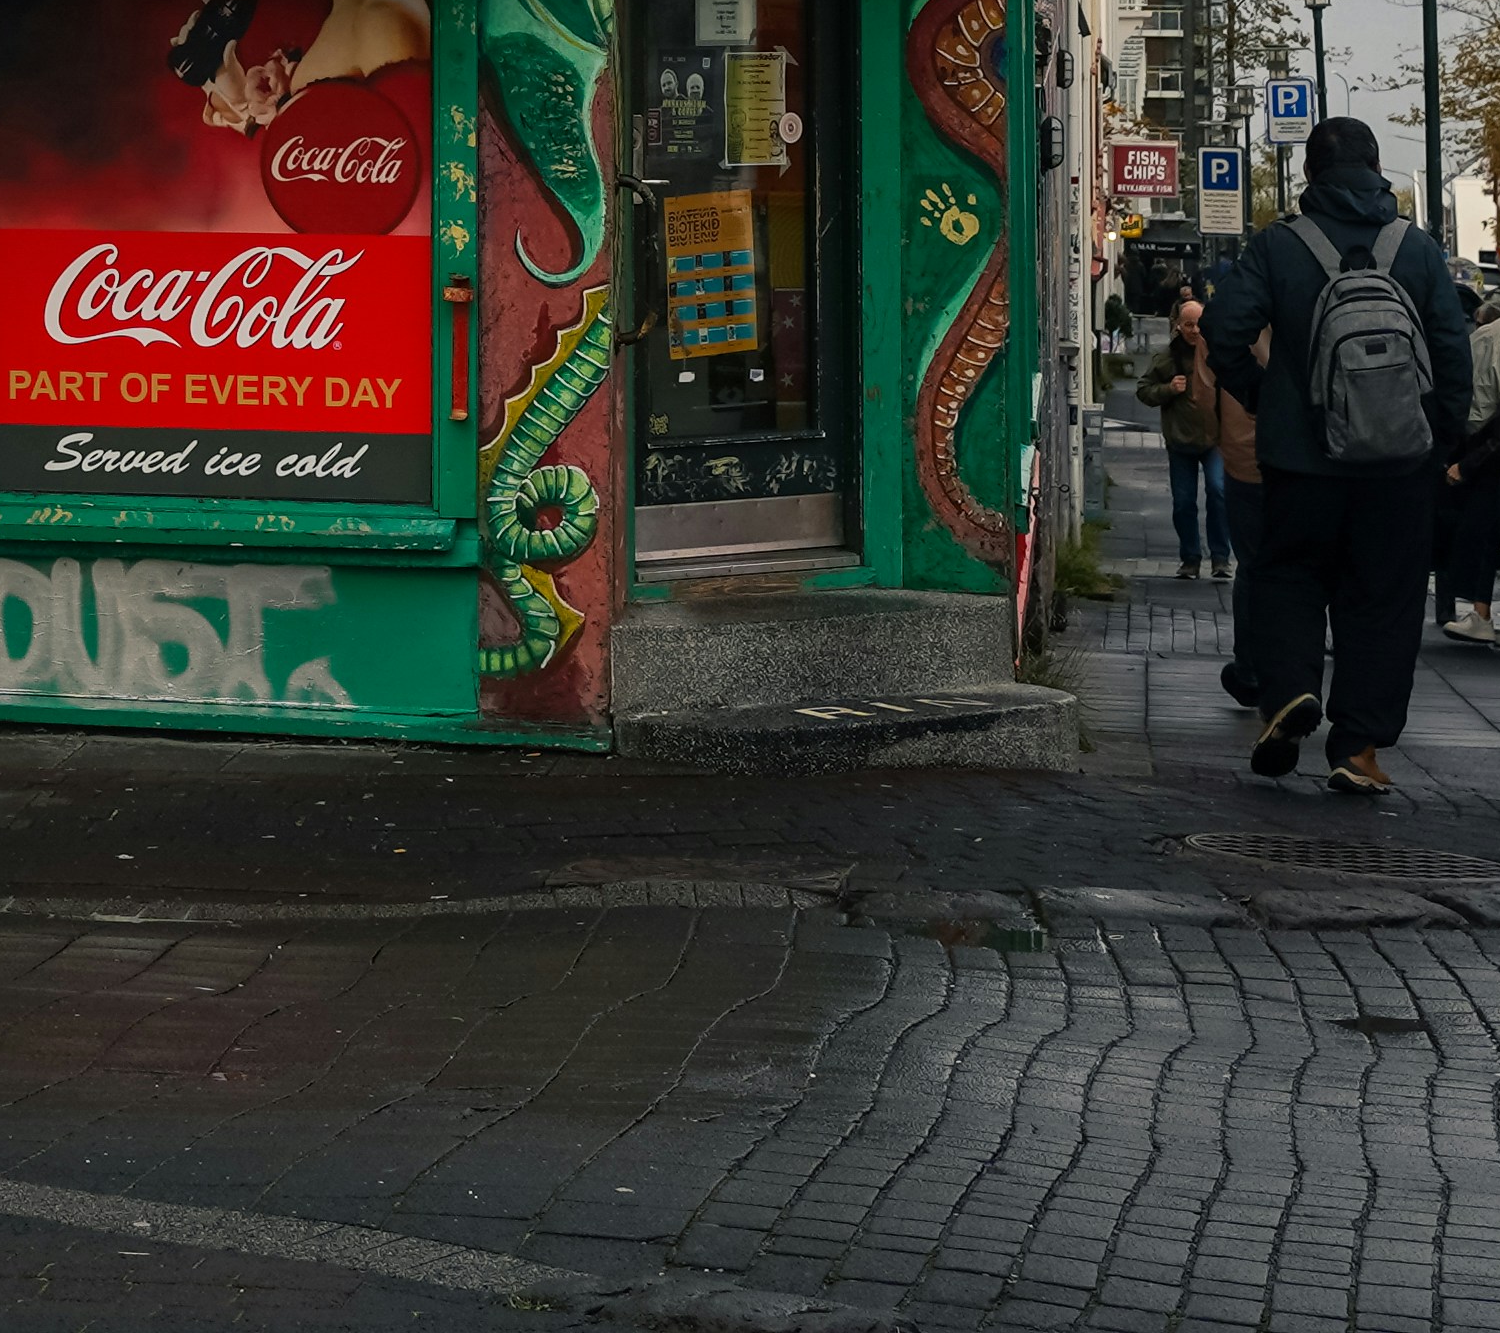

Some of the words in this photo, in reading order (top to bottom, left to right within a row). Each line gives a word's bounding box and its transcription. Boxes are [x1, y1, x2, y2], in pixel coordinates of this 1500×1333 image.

[271, 135, 408, 185] Coca-Cola
[1123, 165, 1165, 180] CHIPS
[44, 243, 365, 351] Coca-Cola
[8, 370, 108, 402] PART
[120, 372, 170, 404] OF
[185, 374, 313, 407] EVERY
[325, 378, 402, 409] DAY
[45, 432, 190, 476] Served
[205, 446, 261, 477] ice
[275, 443, 368, 480] cold
